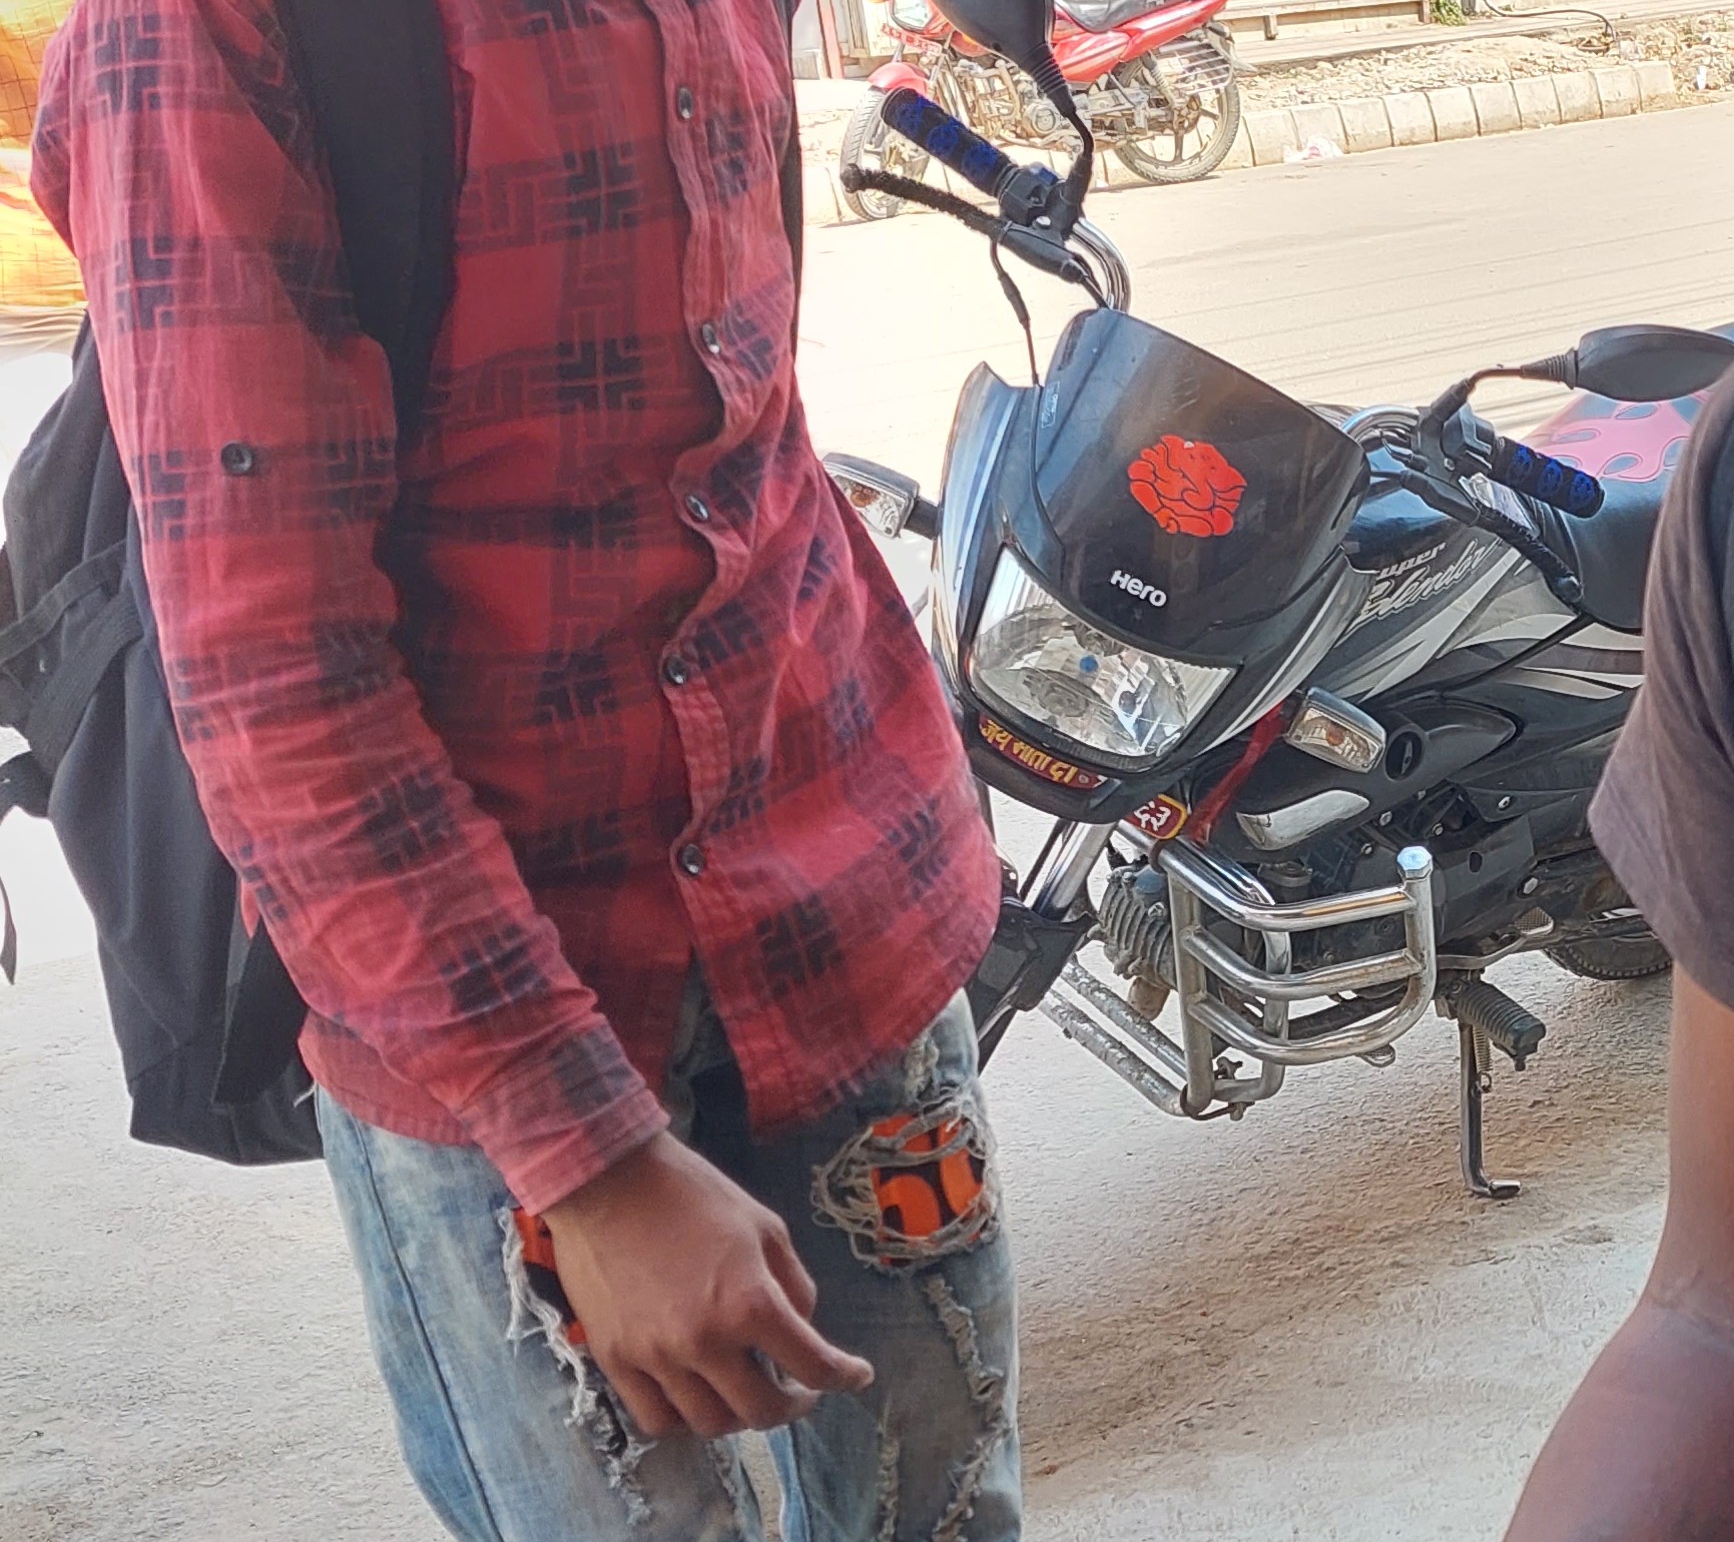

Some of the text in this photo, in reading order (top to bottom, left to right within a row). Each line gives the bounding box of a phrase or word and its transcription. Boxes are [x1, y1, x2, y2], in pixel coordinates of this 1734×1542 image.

[1376, 542, 1447, 581] uper
[1110, 570, 1168, 608] Hero
[979, 719, 1013, 751] जय
